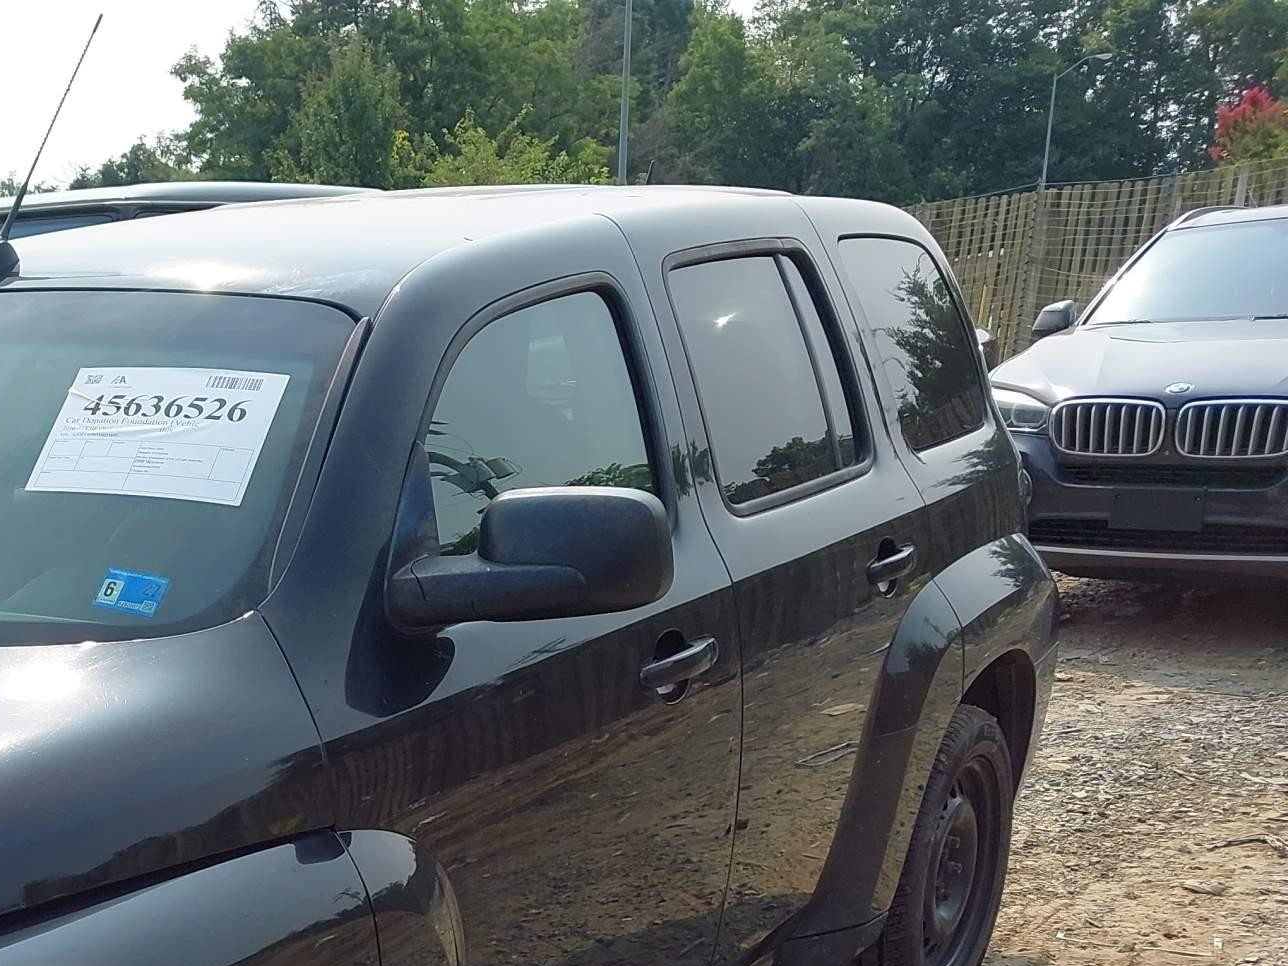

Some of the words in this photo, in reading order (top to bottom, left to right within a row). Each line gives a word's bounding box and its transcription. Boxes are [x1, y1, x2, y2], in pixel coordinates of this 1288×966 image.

[83, 394, 253, 422] 45636526
[65, 416, 80, 425] Car
[82, 416, 119, 426] Donation
[120, 417, 169, 427] Foundation
[103, 581, 117, 597] 6
